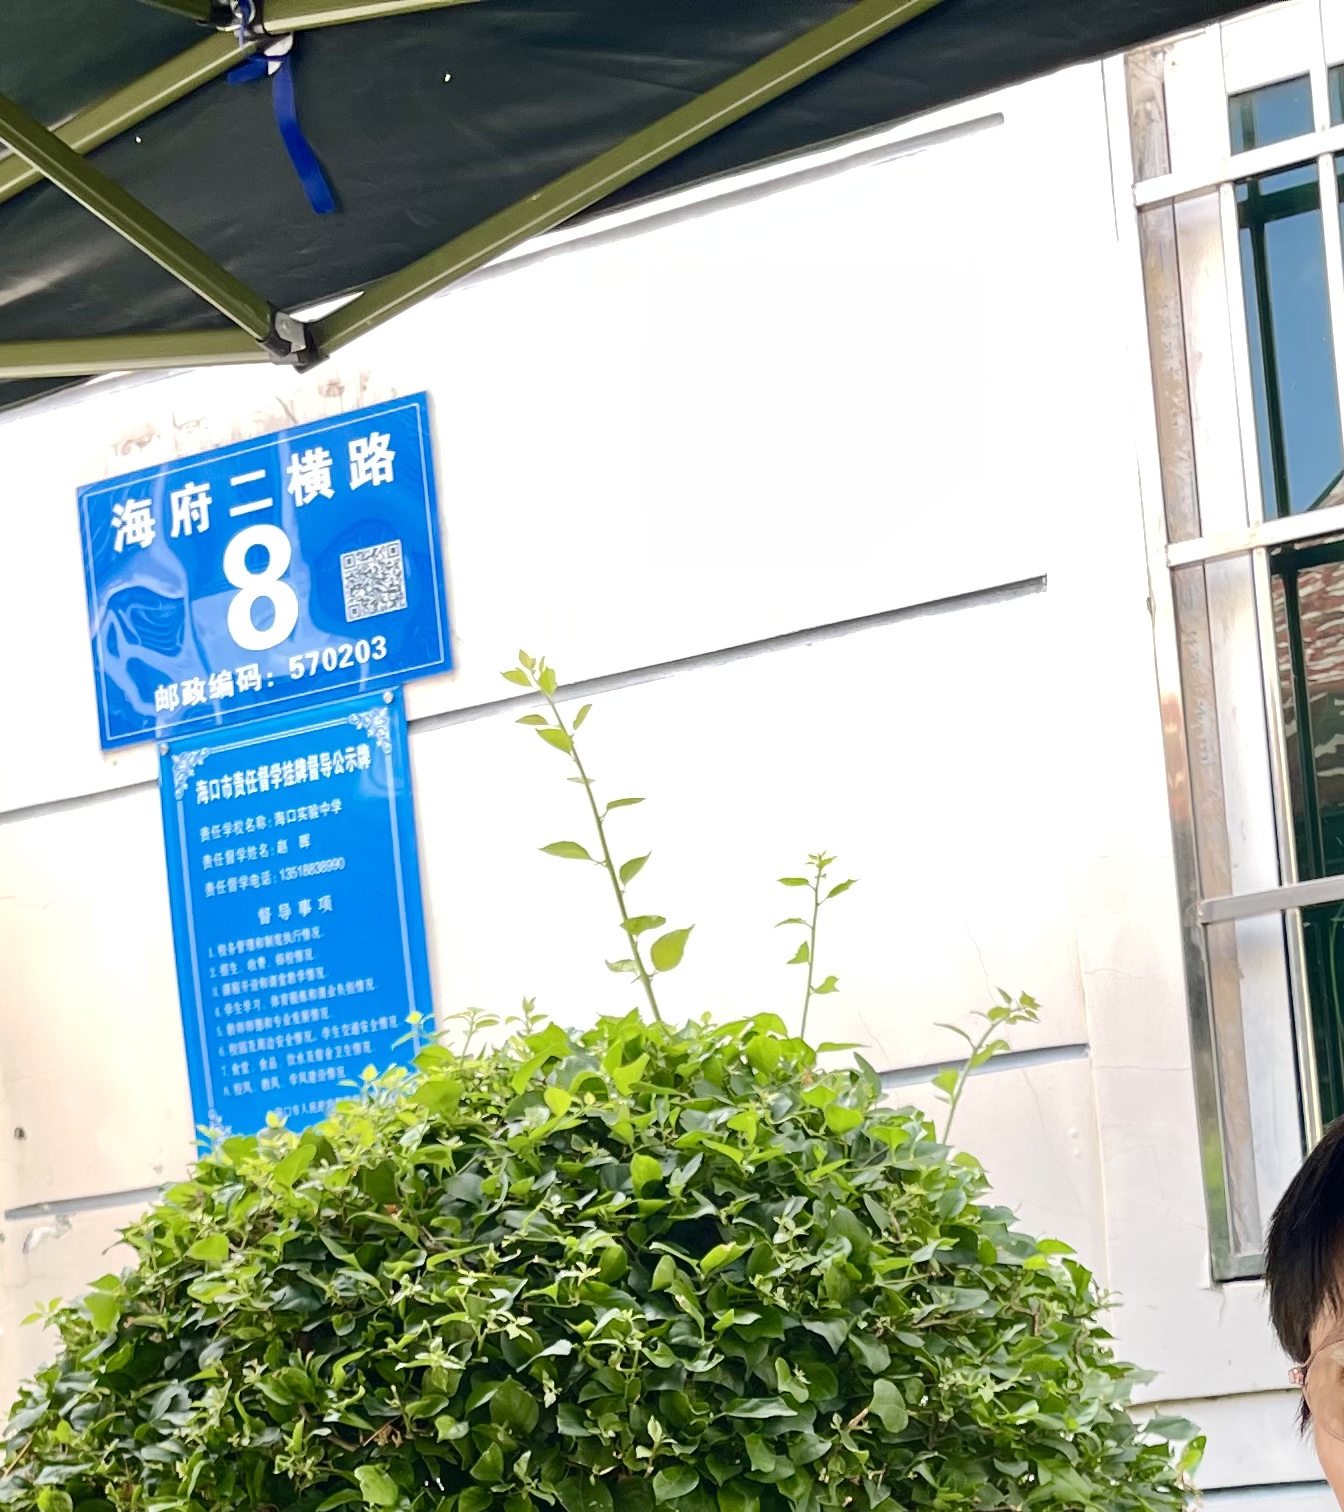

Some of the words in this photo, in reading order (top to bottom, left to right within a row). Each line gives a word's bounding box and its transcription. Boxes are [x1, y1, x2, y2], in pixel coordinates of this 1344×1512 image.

[111, 431, 397, 552] 海府二横路
[223, 523, 298, 651] 8
